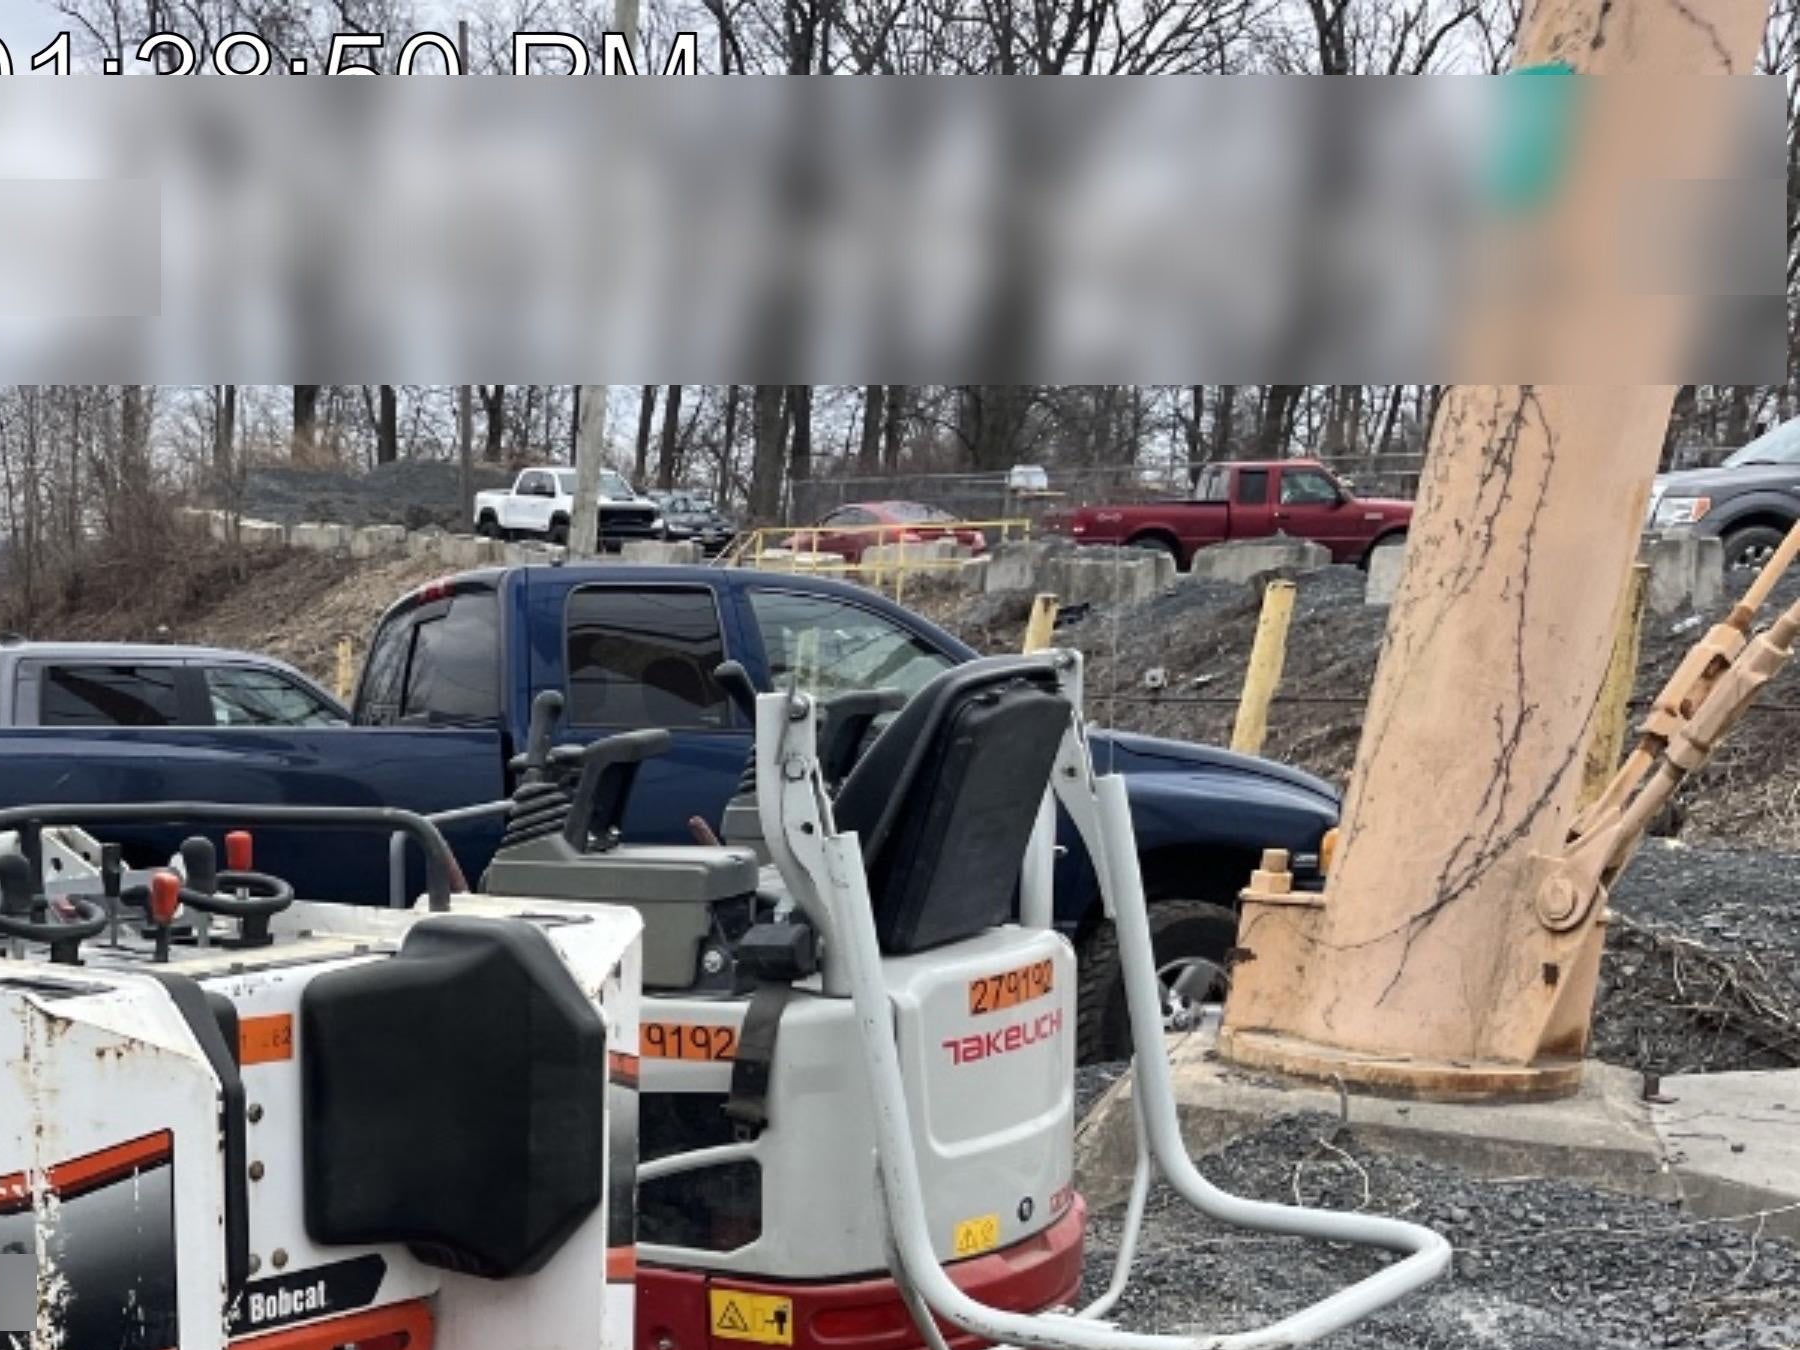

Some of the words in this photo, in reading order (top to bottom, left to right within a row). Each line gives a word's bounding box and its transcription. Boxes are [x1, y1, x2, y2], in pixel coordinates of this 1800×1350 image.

[970, 958, 1052, 1014] 279192
[644, 1023, 737, 1061] 9192
[249, 1279, 327, 1323] Bobcat
